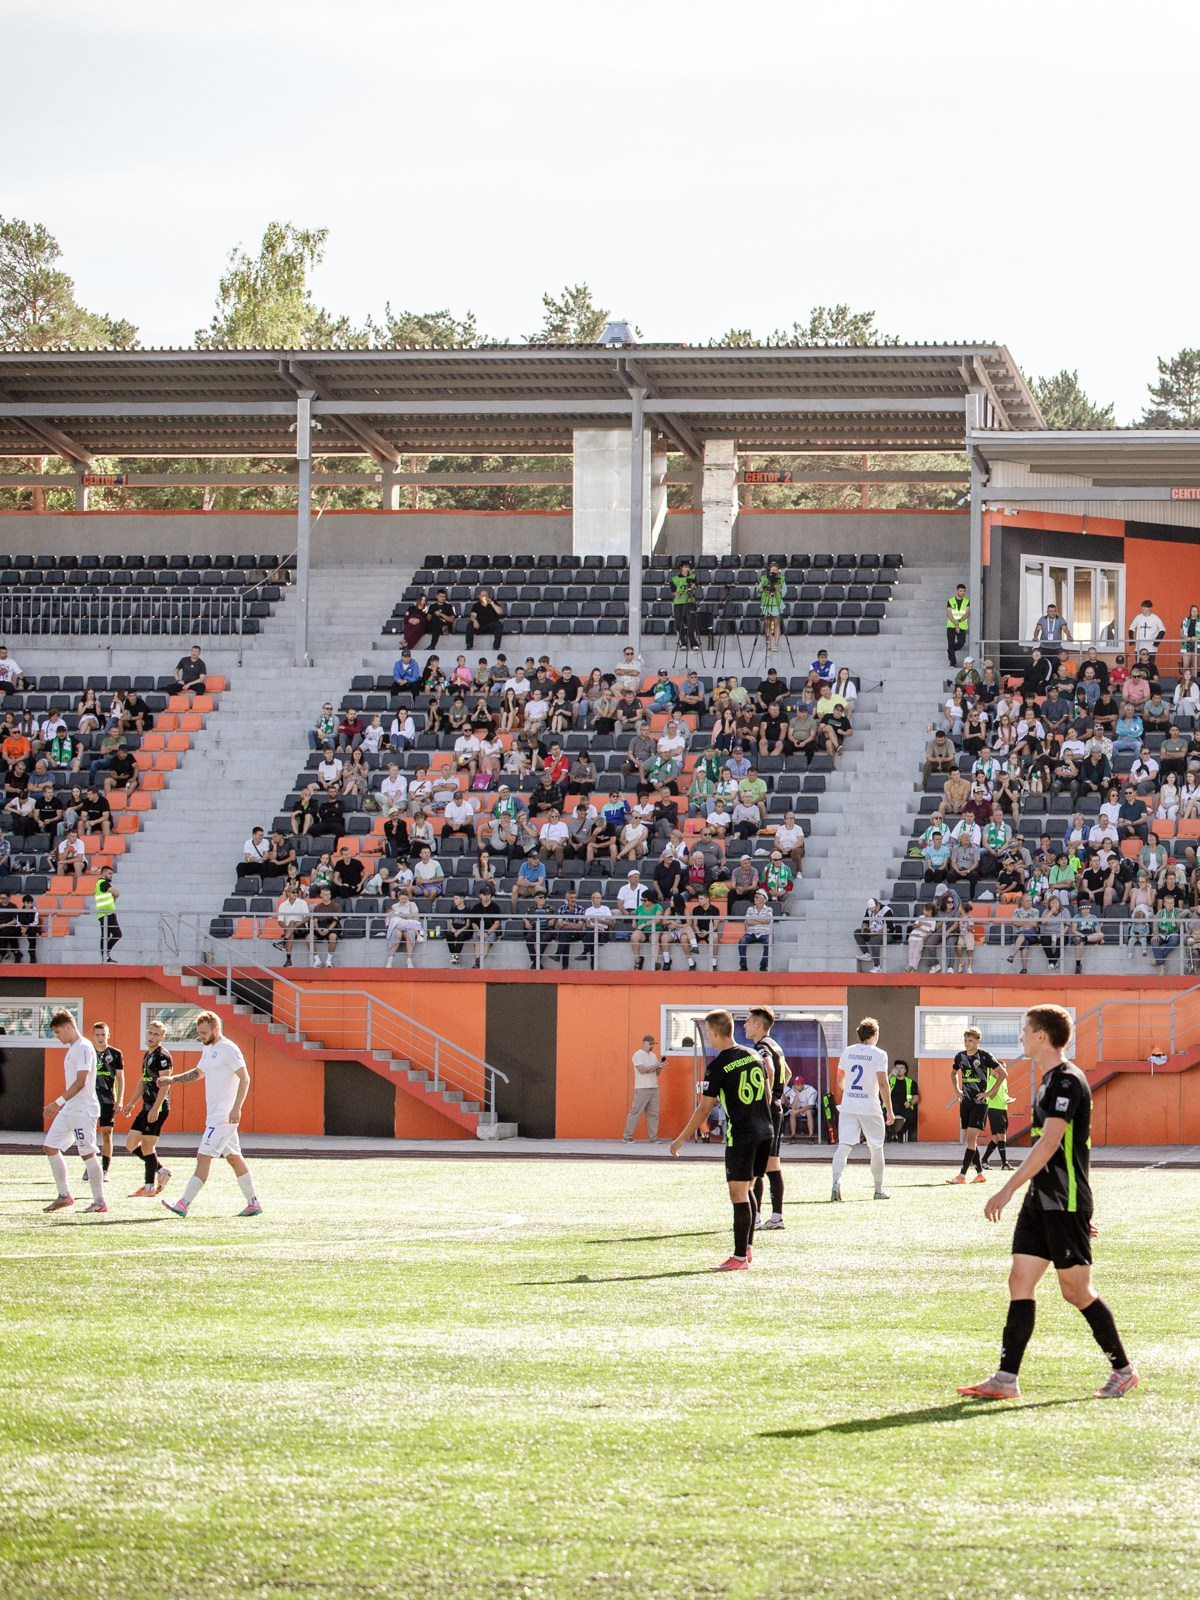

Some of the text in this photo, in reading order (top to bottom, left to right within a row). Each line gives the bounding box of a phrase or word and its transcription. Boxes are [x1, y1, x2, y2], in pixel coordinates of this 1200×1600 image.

[83, 474, 127, 486] СЕКТОР 1
[746, 471, 792, 482] СЕКТОР 2
[850, 1064, 864, 1090] 2
[738, 1066, 764, 1104] 69
[74, 1128, 84, 1140] 15
[208, 1127, 215, 1139] 7
